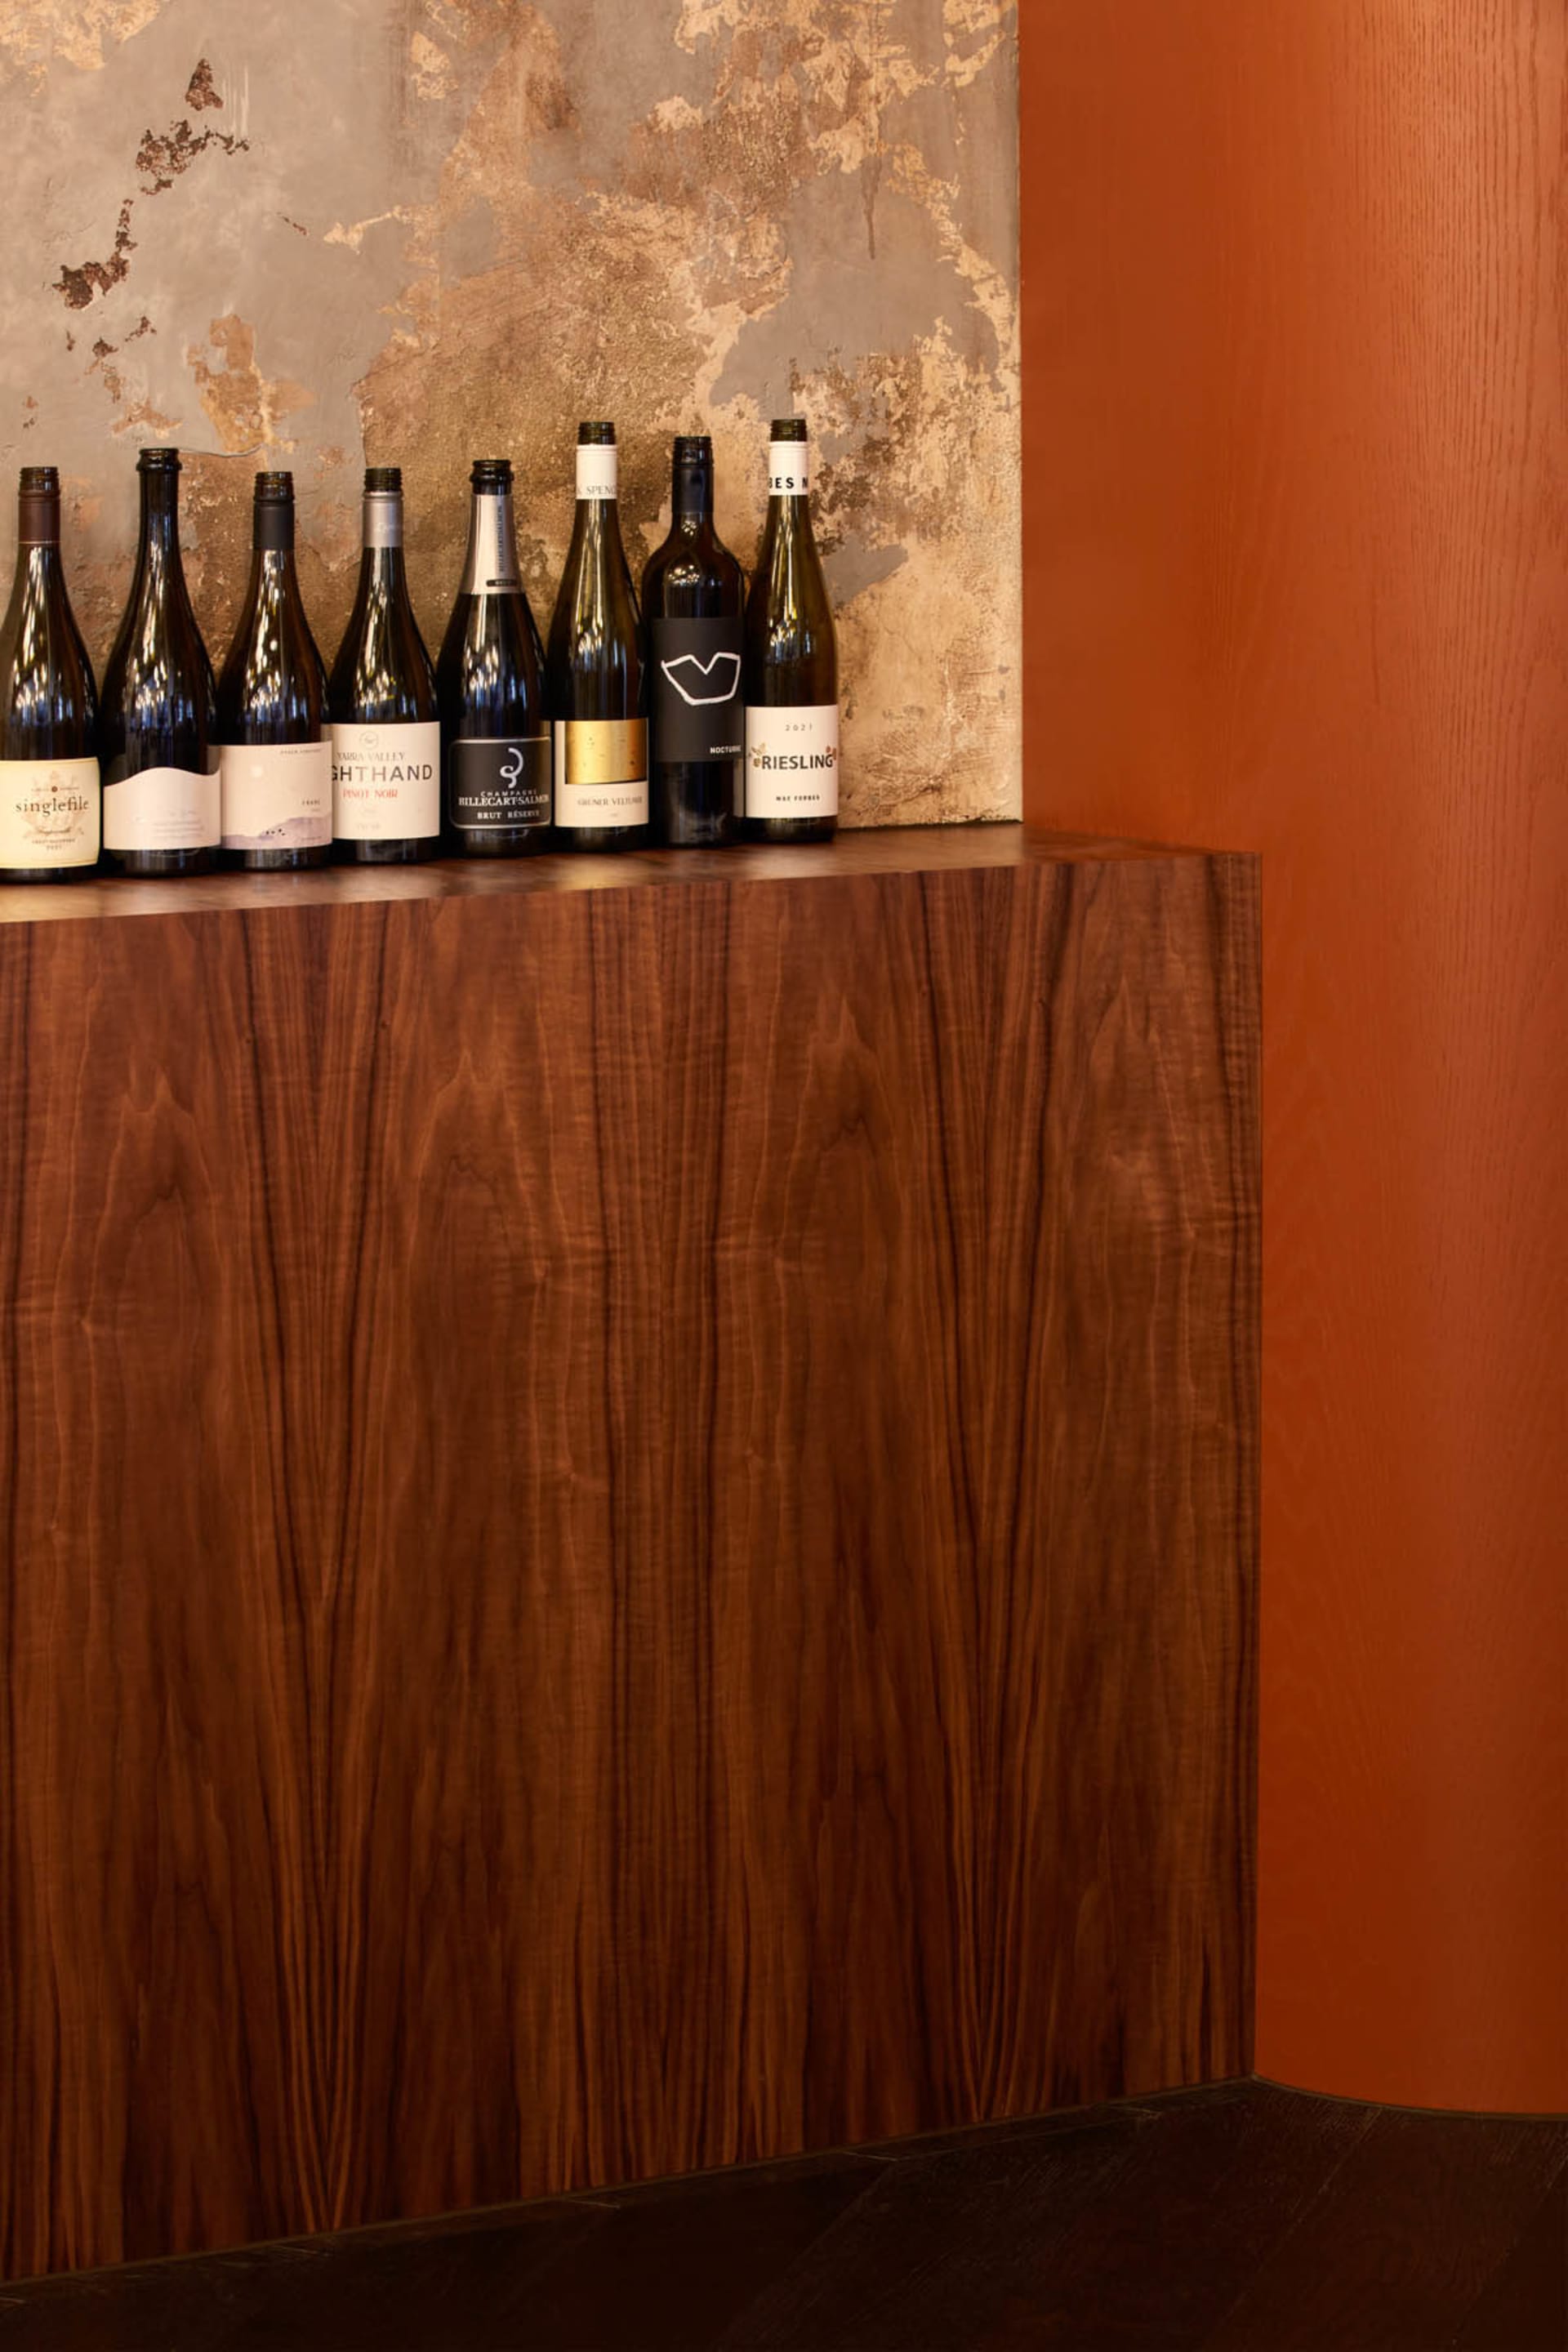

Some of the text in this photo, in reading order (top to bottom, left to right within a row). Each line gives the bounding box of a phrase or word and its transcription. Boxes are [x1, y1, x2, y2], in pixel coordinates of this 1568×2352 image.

[785, 724, 813, 732] 2021
[367, 751, 406, 761] VALLEY
[762, 754, 833, 770] RIESLING
[343, 789, 399, 798] PINOT NOIR
[16, 795, 89, 817] singlefile
[477, 812, 502, 820] BRUT
